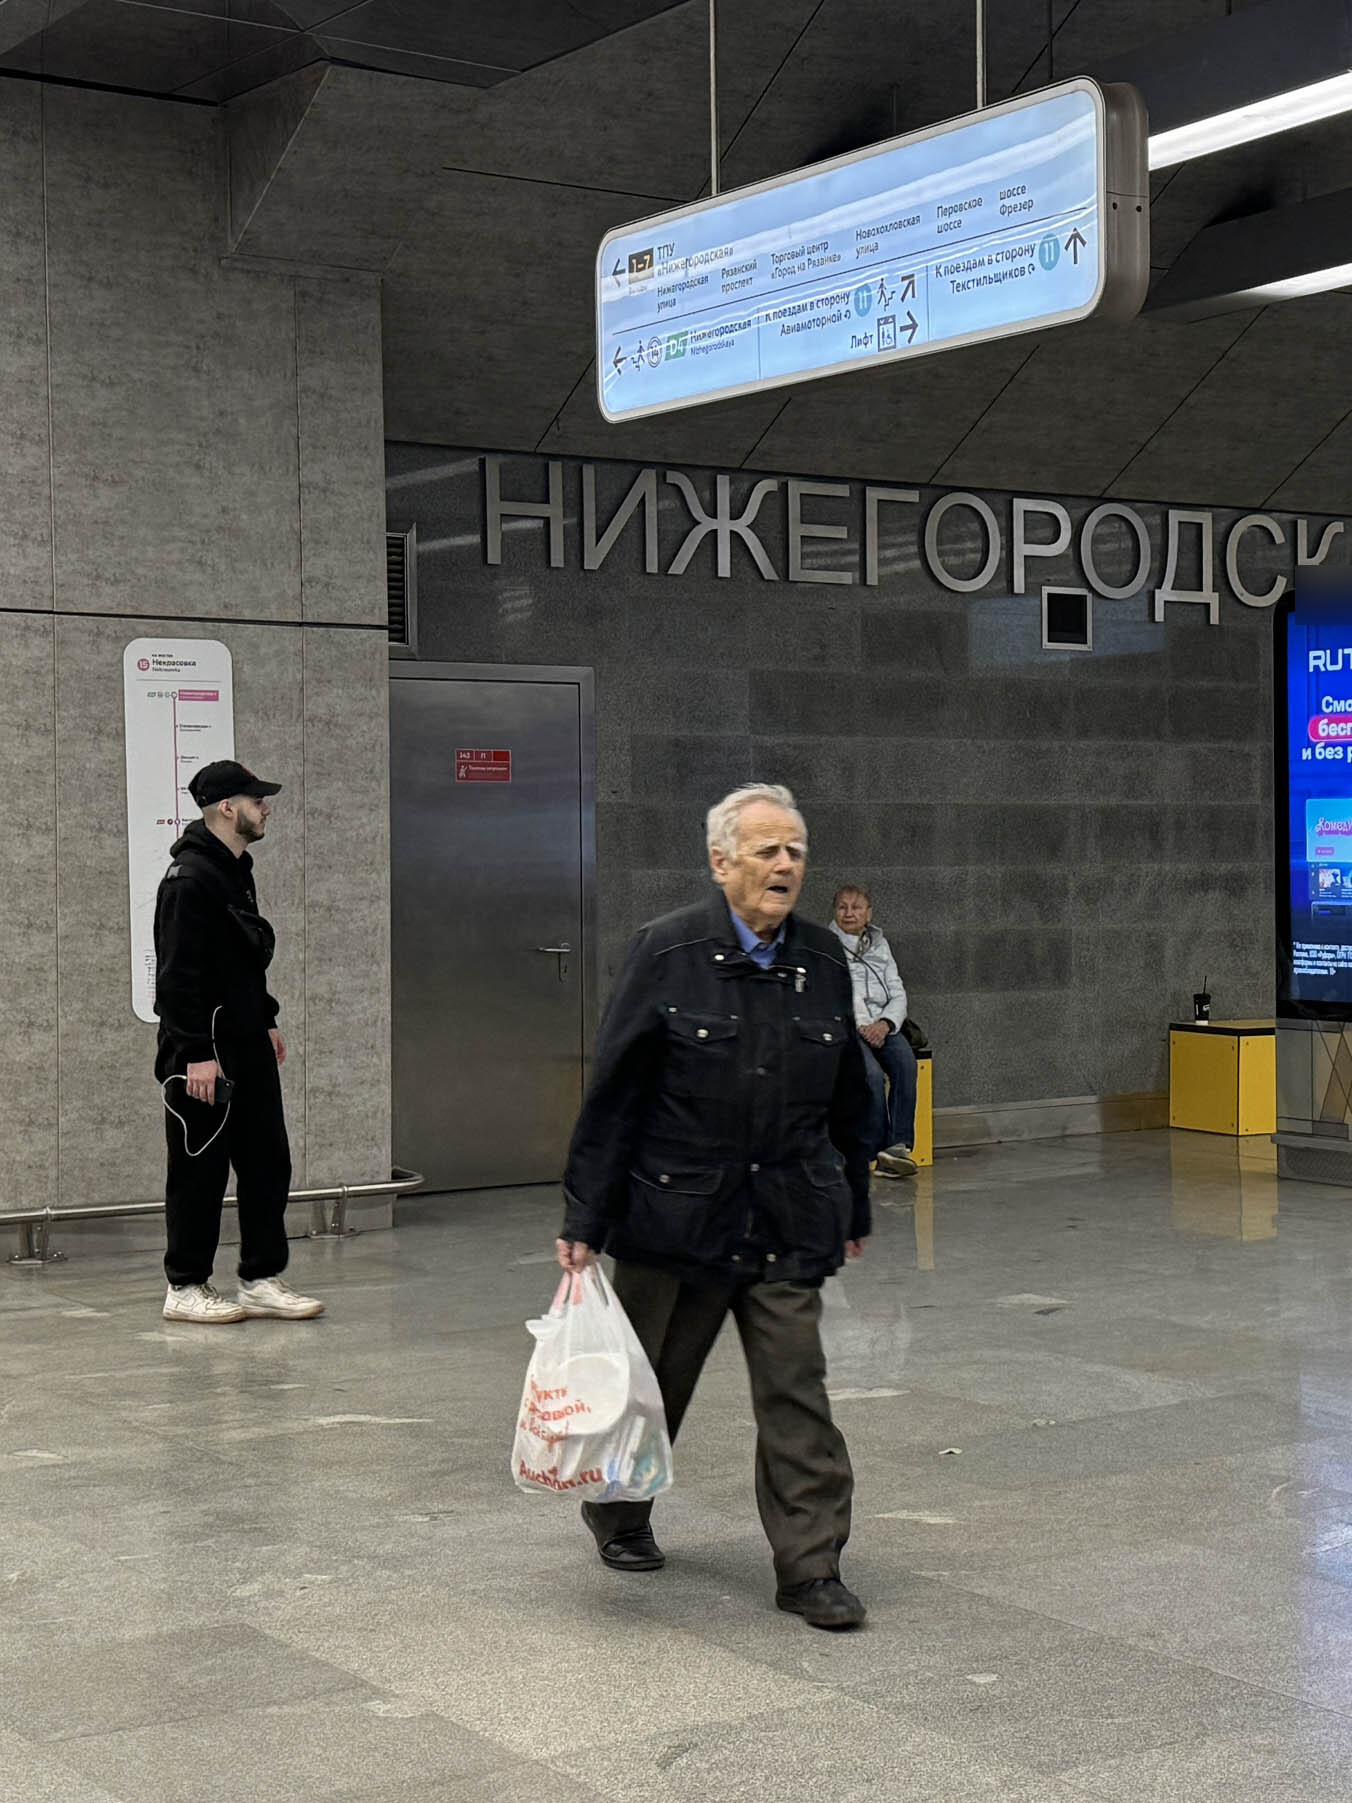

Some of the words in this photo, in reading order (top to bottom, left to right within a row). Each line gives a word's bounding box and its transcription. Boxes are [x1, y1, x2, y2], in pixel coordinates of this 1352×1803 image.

[999, 184, 1027, 200] шоссе
[936, 196, 983, 218] Перовское
[999, 198, 1034, 217] Фрезер
[855, 215, 921, 241] Новохохловская
[936, 218, 963, 234] шоссе
[657, 242, 675, 260] ТПУ
[770, 248, 806, 266] Торговый
[806, 240, 829, 256] центр
[855, 241, 879, 259] улица
[935, 264, 943, 279] К
[943, 256, 986, 278] поездам
[987, 254, 994, 265] в
[994, 242, 1037, 263] сторону
[1044, 241, 1055, 264] 11
[657, 246, 734, 277] «Нижегородская»
[721, 259, 758, 280] Рязанский
[771, 265, 797, 280] «Город
[797, 262, 807, 272] на
[807, 253, 842, 271] Рязанке»
[657, 274, 709, 297] Нижегородская
[721, 277, 754, 294] проспект
[949, 265, 1026, 294] Текстильщиков
[657, 297, 677, 314] улица
[772, 301, 808, 320] поездам
[809, 300, 815, 311] в
[815, 291, 851, 310] сторону
[780, 309, 843, 336] Авиамоторной
[850, 331, 874, 349] Лифт
[152, 658, 197, 667] Некрасовка
[1301, 747, 1312, 761] и
[1314, 741, 1344, 760] без
